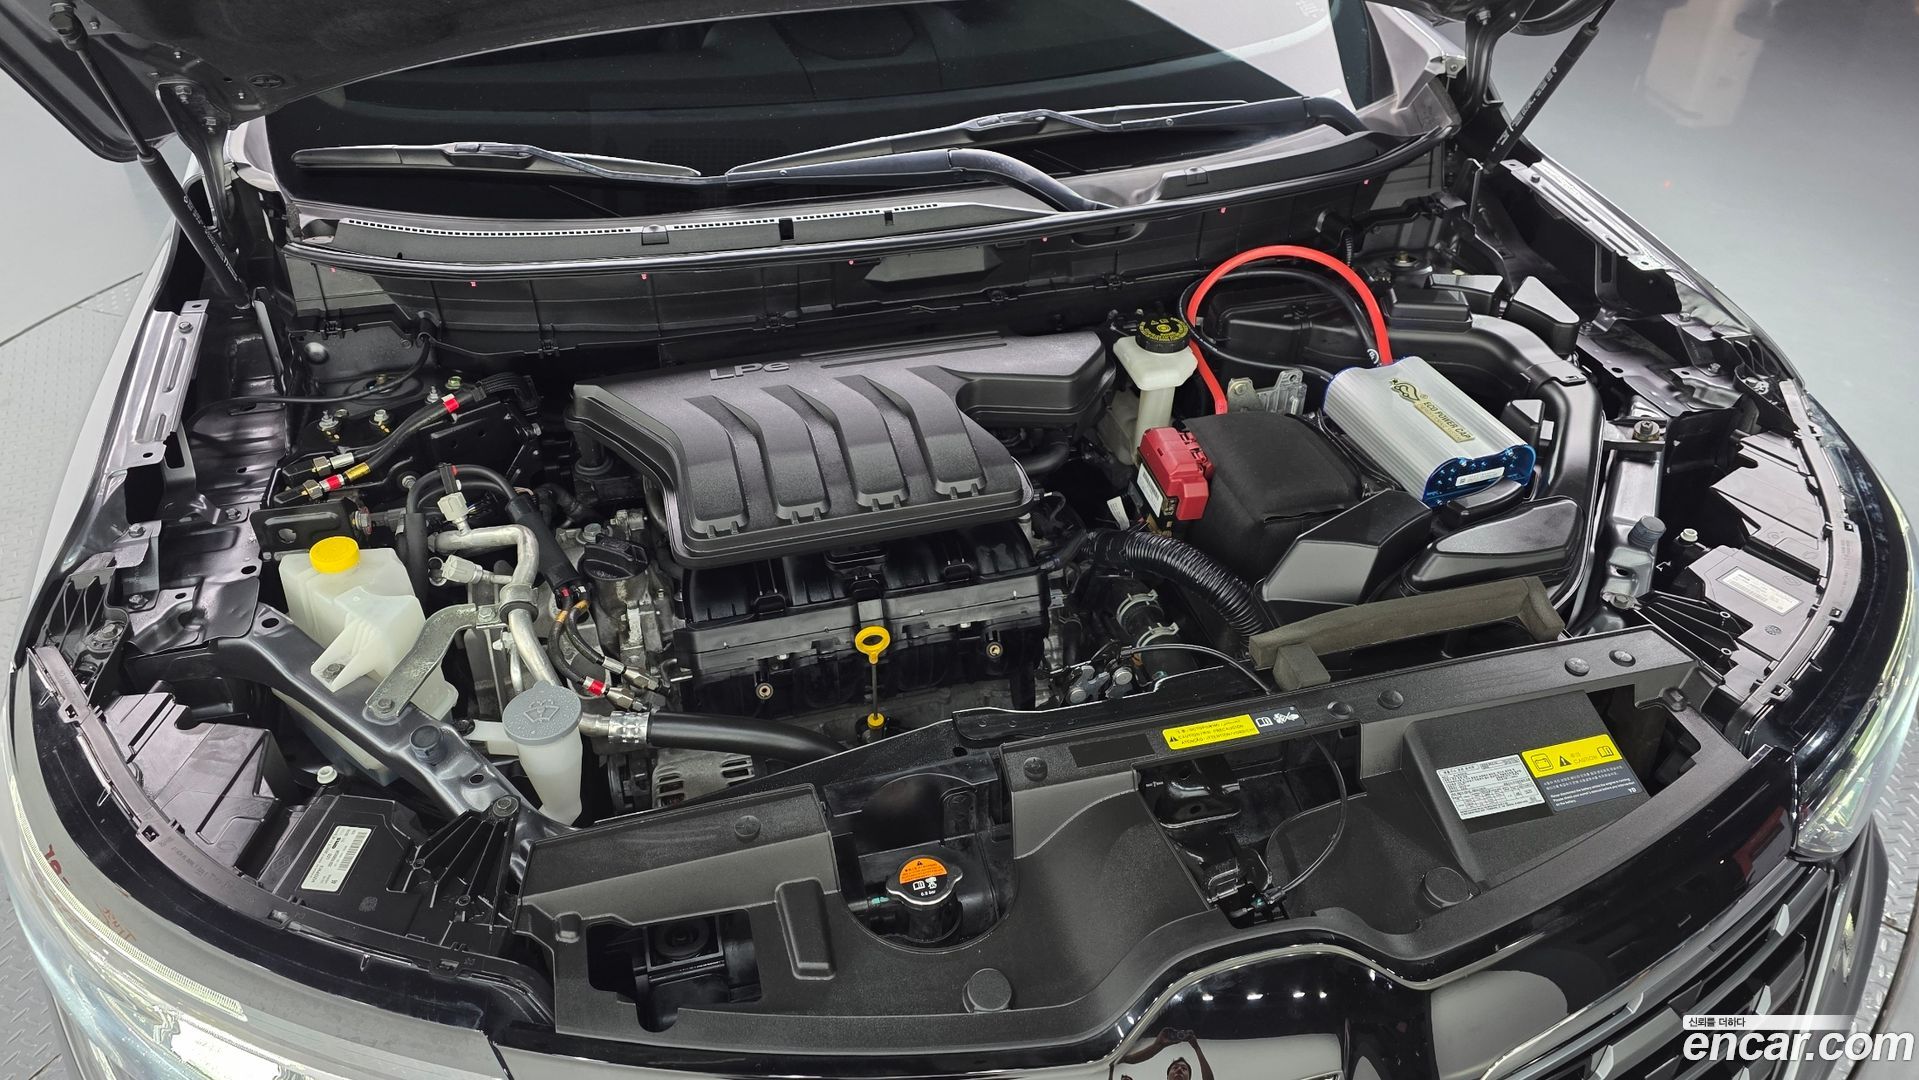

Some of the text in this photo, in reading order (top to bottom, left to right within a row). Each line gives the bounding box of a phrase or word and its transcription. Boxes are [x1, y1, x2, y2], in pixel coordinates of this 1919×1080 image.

[709, 362, 790, 381] LPe
[1423, 401, 1471, 438] ECO POWER CAP
[1574, 755, 1598, 764] CAUTION
